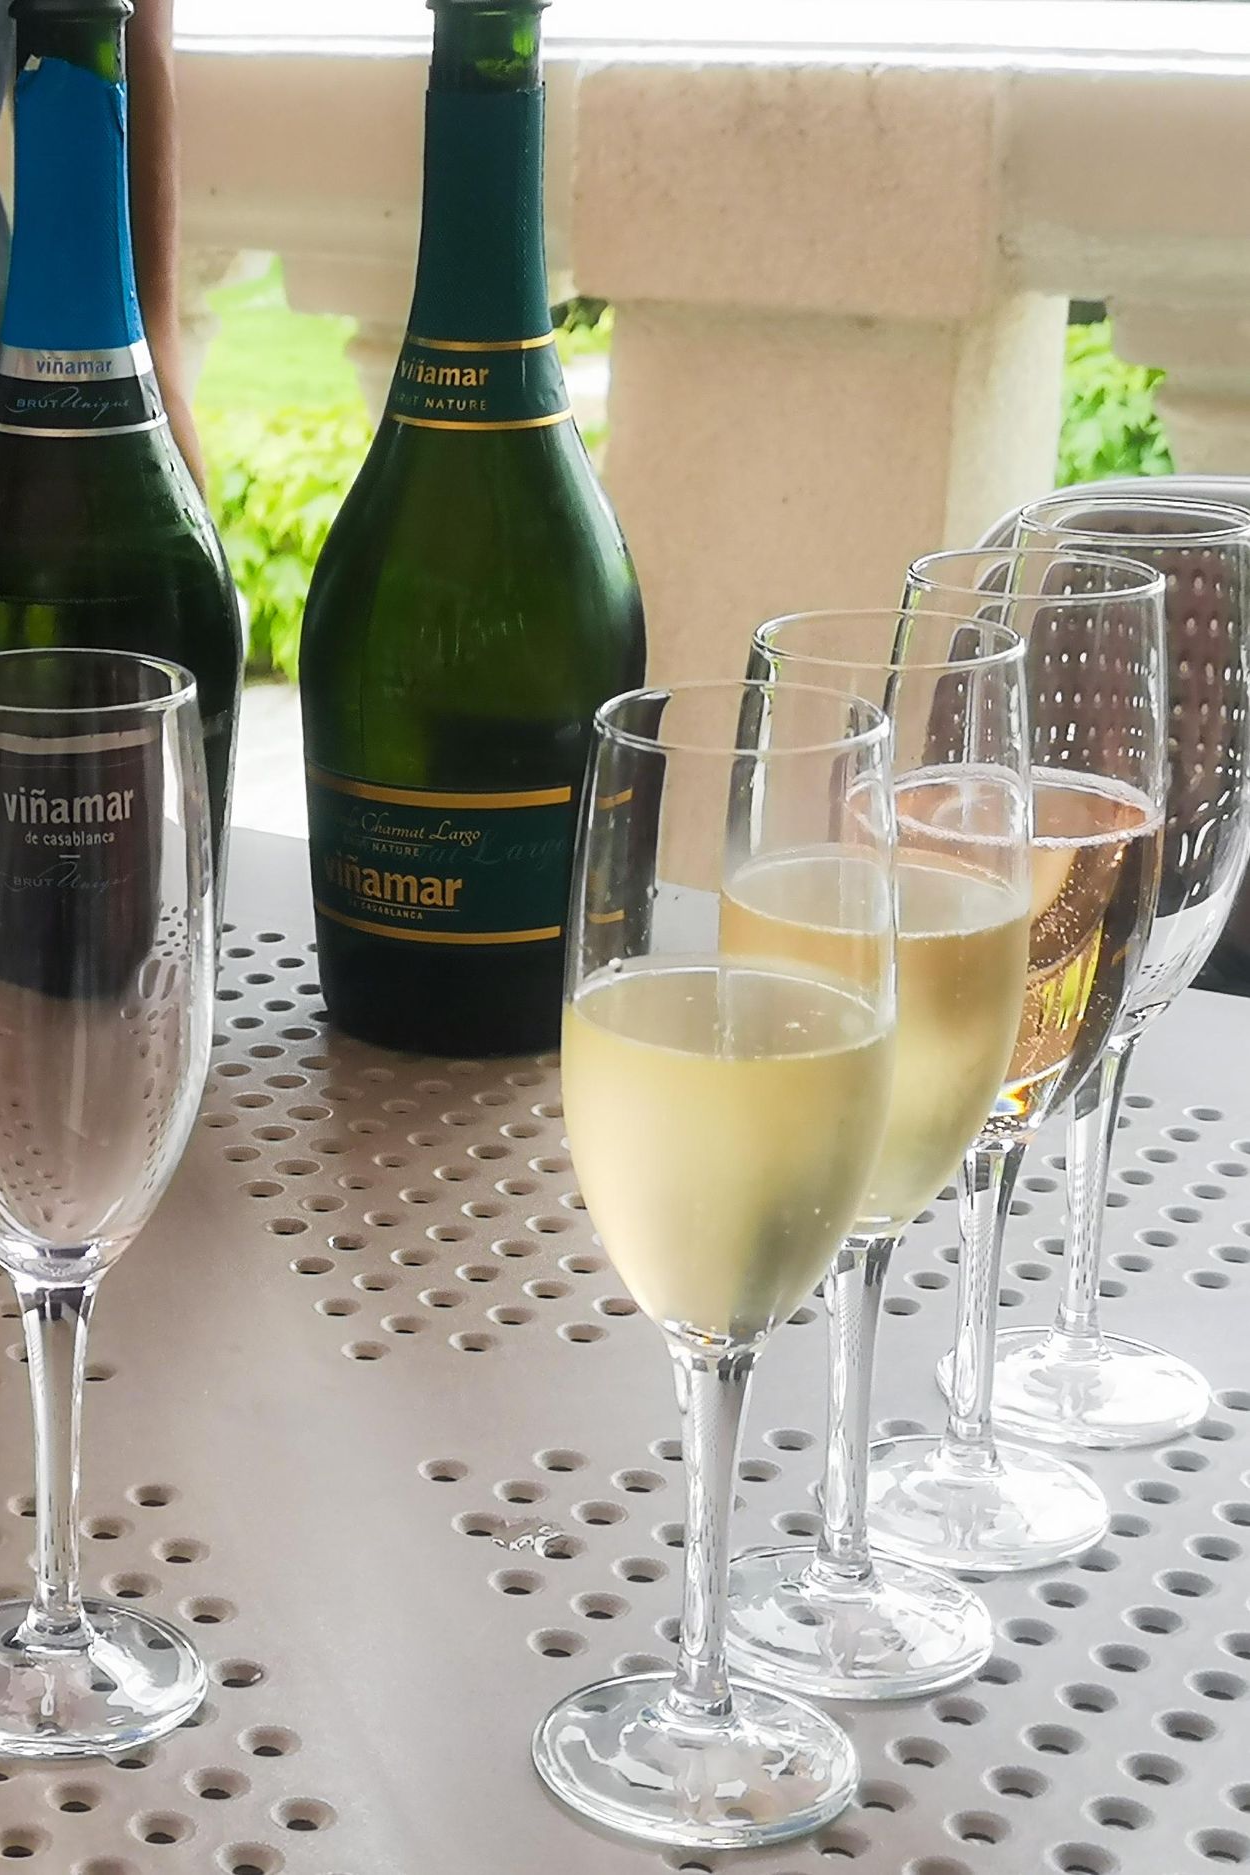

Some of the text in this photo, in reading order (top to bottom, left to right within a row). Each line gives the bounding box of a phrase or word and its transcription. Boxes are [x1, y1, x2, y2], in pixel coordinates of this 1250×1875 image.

[35, 356, 112, 375] viñamar
[16, 398, 58, 409] BRUT
[424, 398, 487, 411] NATURE
[3, 786, 134, 824] viñamar
[361, 812, 425, 839] Charmat
[429, 820, 481, 846] Largo
[25, 831, 116, 847] de casablanca
[372, 842, 420, 857] NATURE
[13, 876, 53, 888] BRUT
